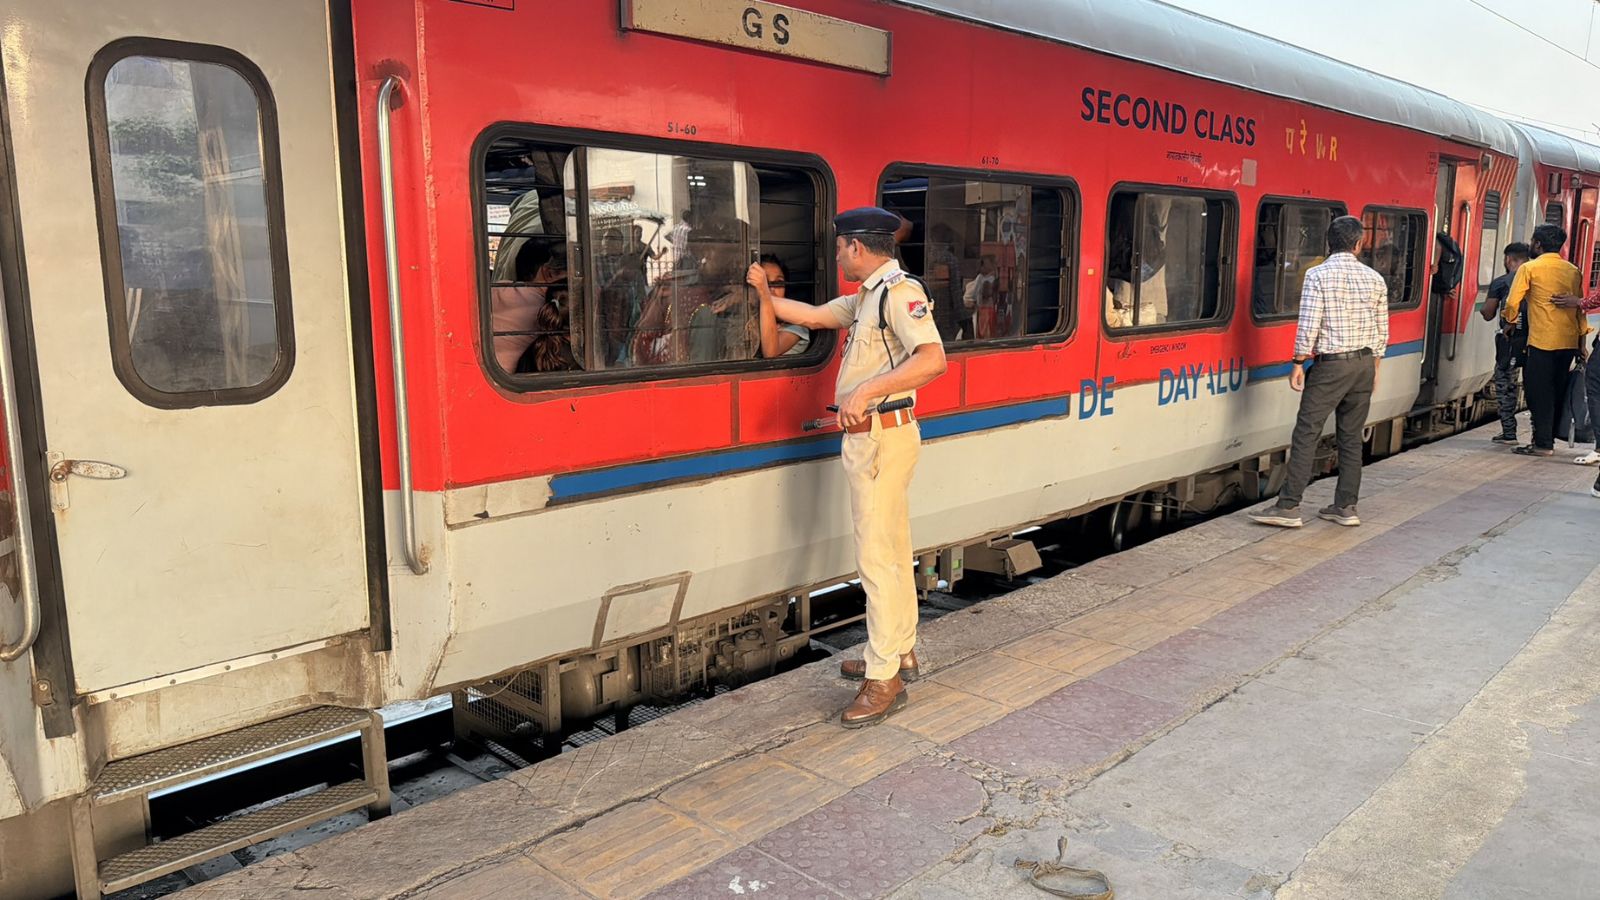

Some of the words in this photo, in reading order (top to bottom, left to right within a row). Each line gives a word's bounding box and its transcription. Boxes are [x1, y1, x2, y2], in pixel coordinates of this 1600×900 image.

[667, 122, 697, 136] 51-60
[1080, 86, 1187, 135] SECOND
[1194, 109, 1256, 147] CLASS
[981, 156, 1000, 165] 61-70
[1079, 376, 1115, 420] DE
